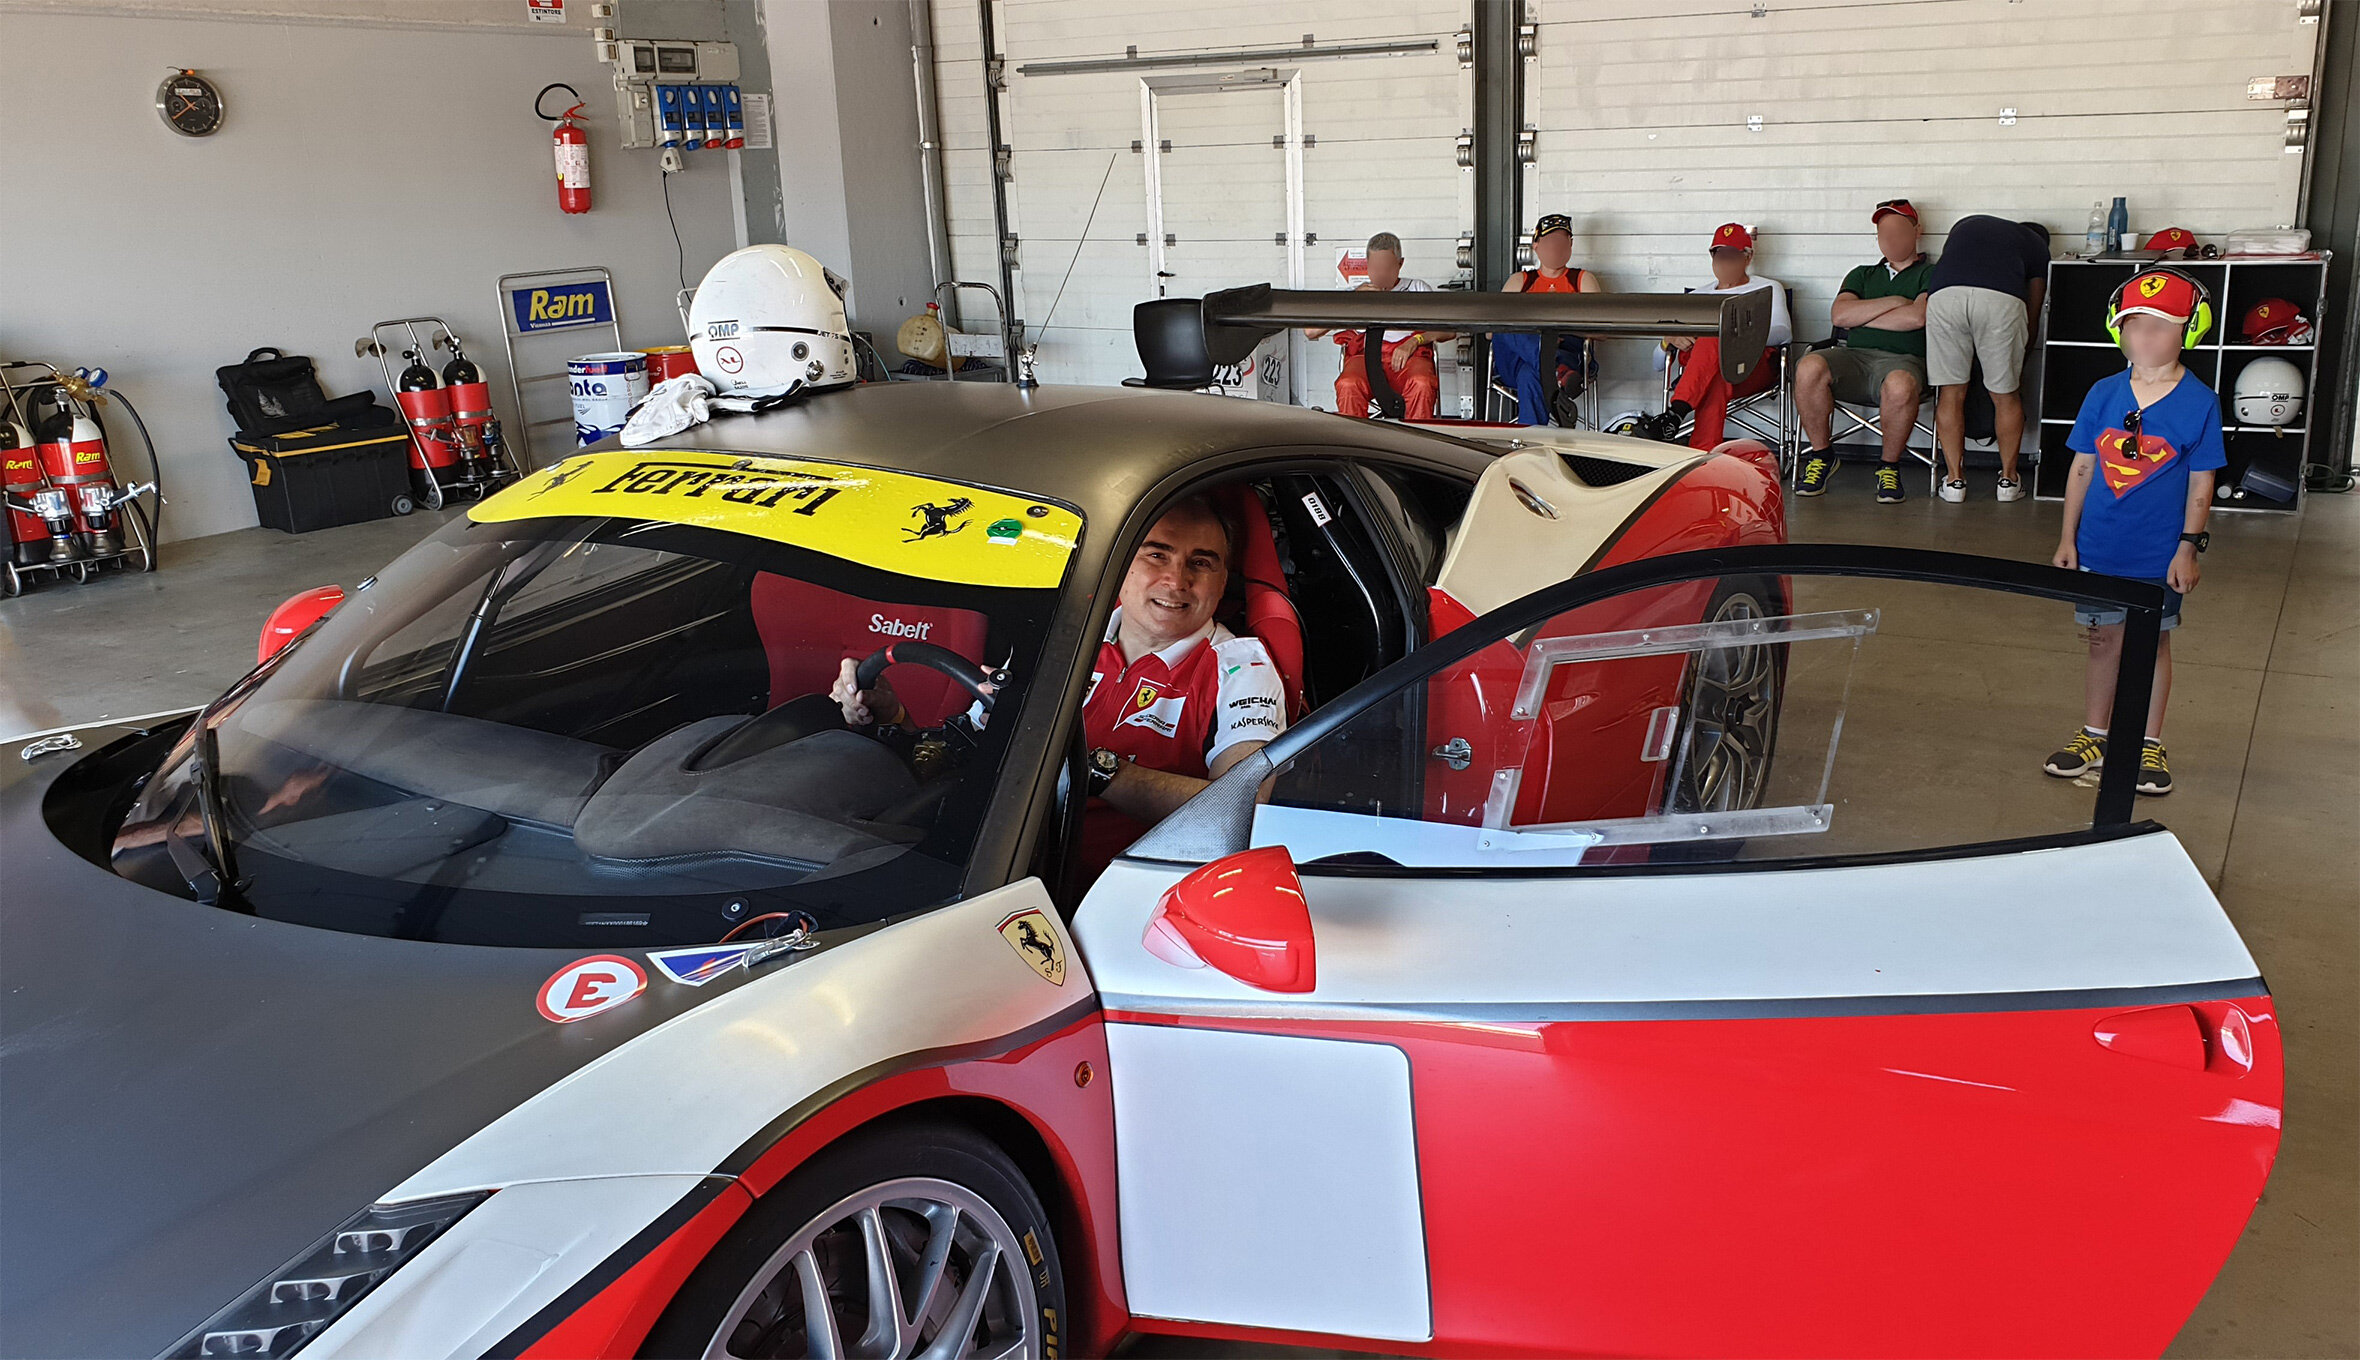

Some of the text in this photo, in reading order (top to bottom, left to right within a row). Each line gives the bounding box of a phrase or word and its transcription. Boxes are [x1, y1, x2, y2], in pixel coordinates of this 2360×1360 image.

[529, 290, 594, 321] Ram
[708, 323, 739, 338] OMP
[1263, 356, 1281, 386] 223
[6, 460, 33, 469] Ram
[76, 452, 101, 463] Ram
[592, 462, 842, 517] Ferrari
[868, 613, 931, 640] Sabelt
[565, 973, 617, 1009] E
